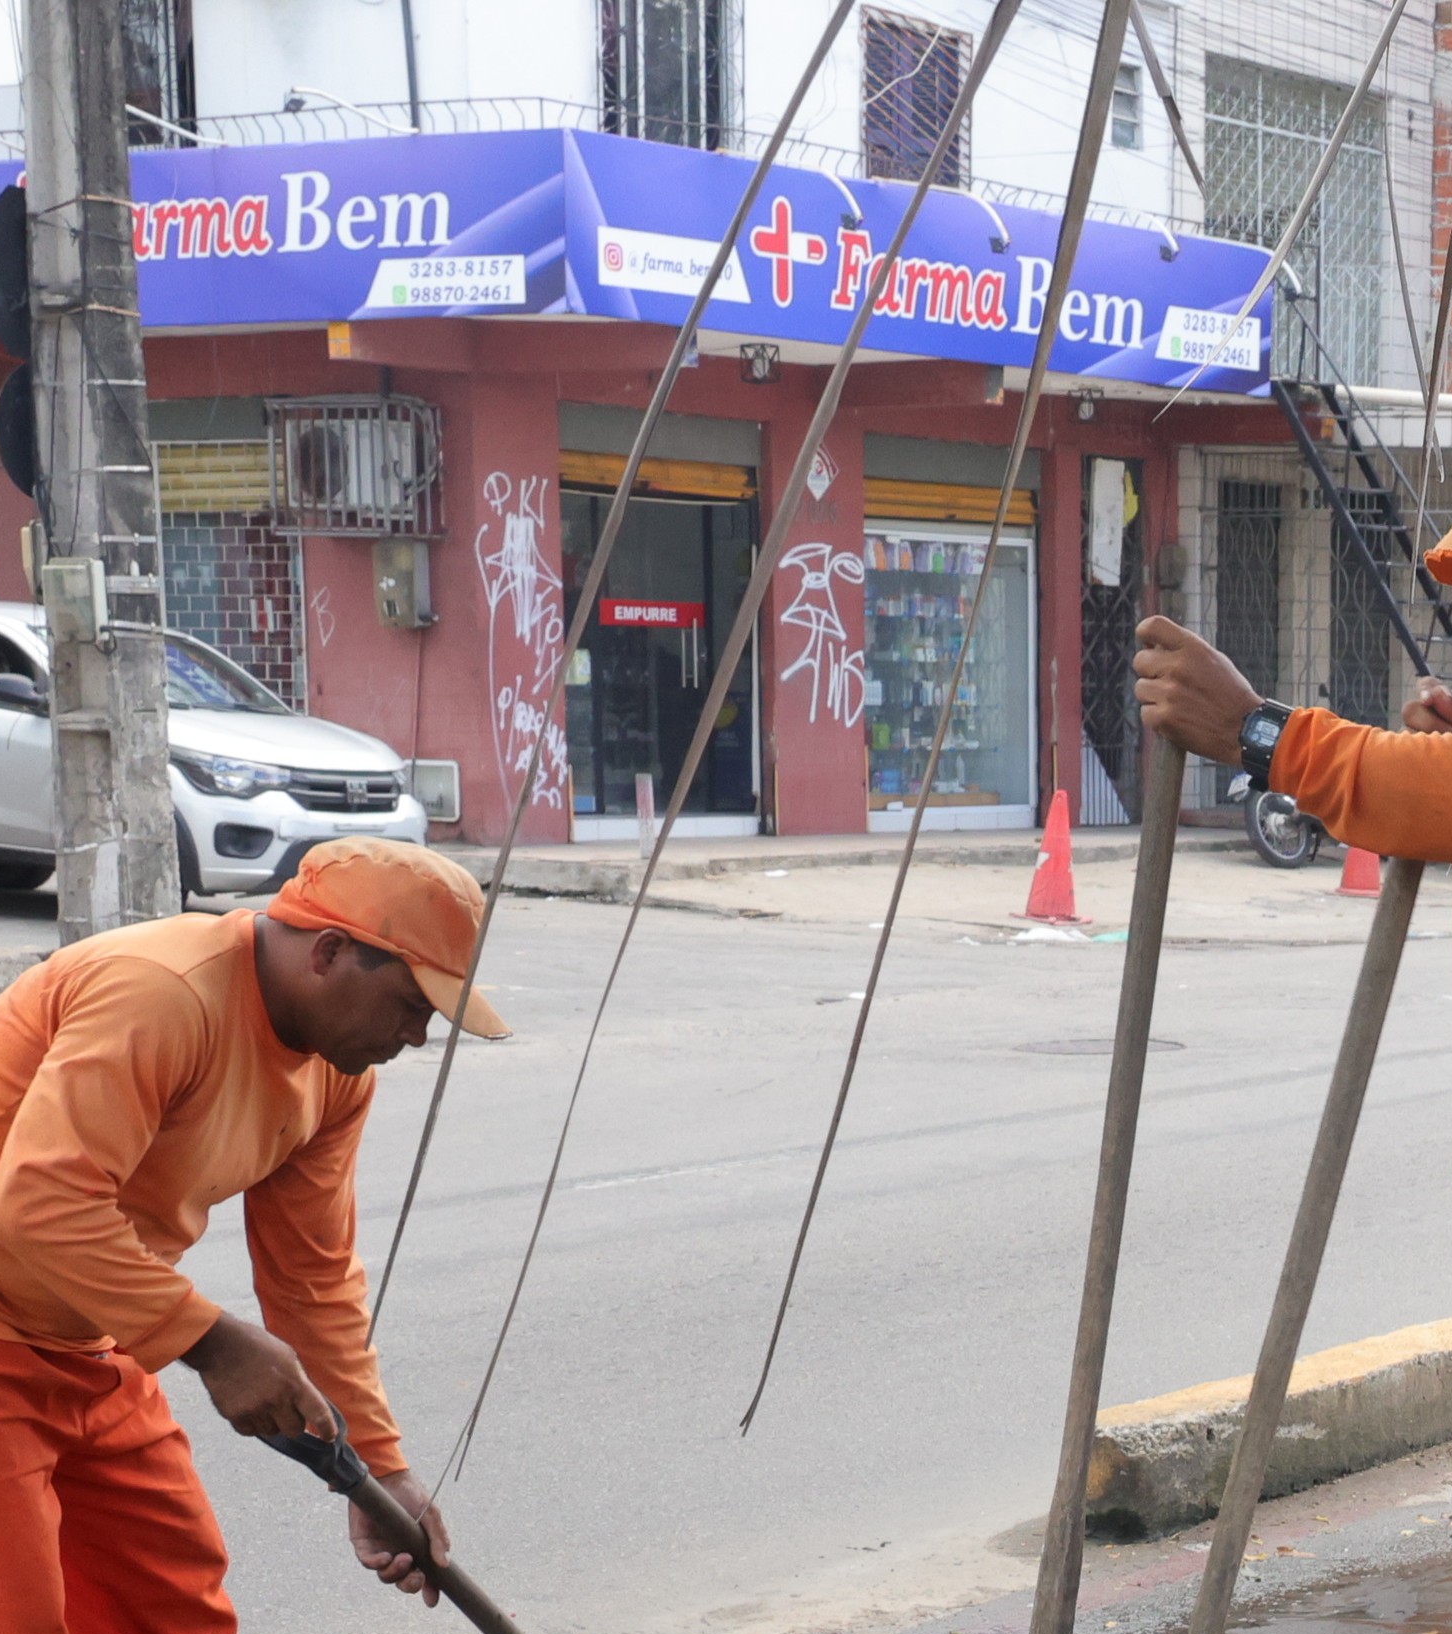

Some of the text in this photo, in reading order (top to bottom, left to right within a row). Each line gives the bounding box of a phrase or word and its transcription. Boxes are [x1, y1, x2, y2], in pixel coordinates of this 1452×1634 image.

[132, 170, 453, 262] arma Bem
[409, 259, 513, 278] 3283-8157
[410, 285, 512, 303] 98870-2461
[830, 226, 1144, 349] Farma Bem
[1183, 313, 1253, 338] 3283-857
[614, 606, 677, 622] EMPURRE
